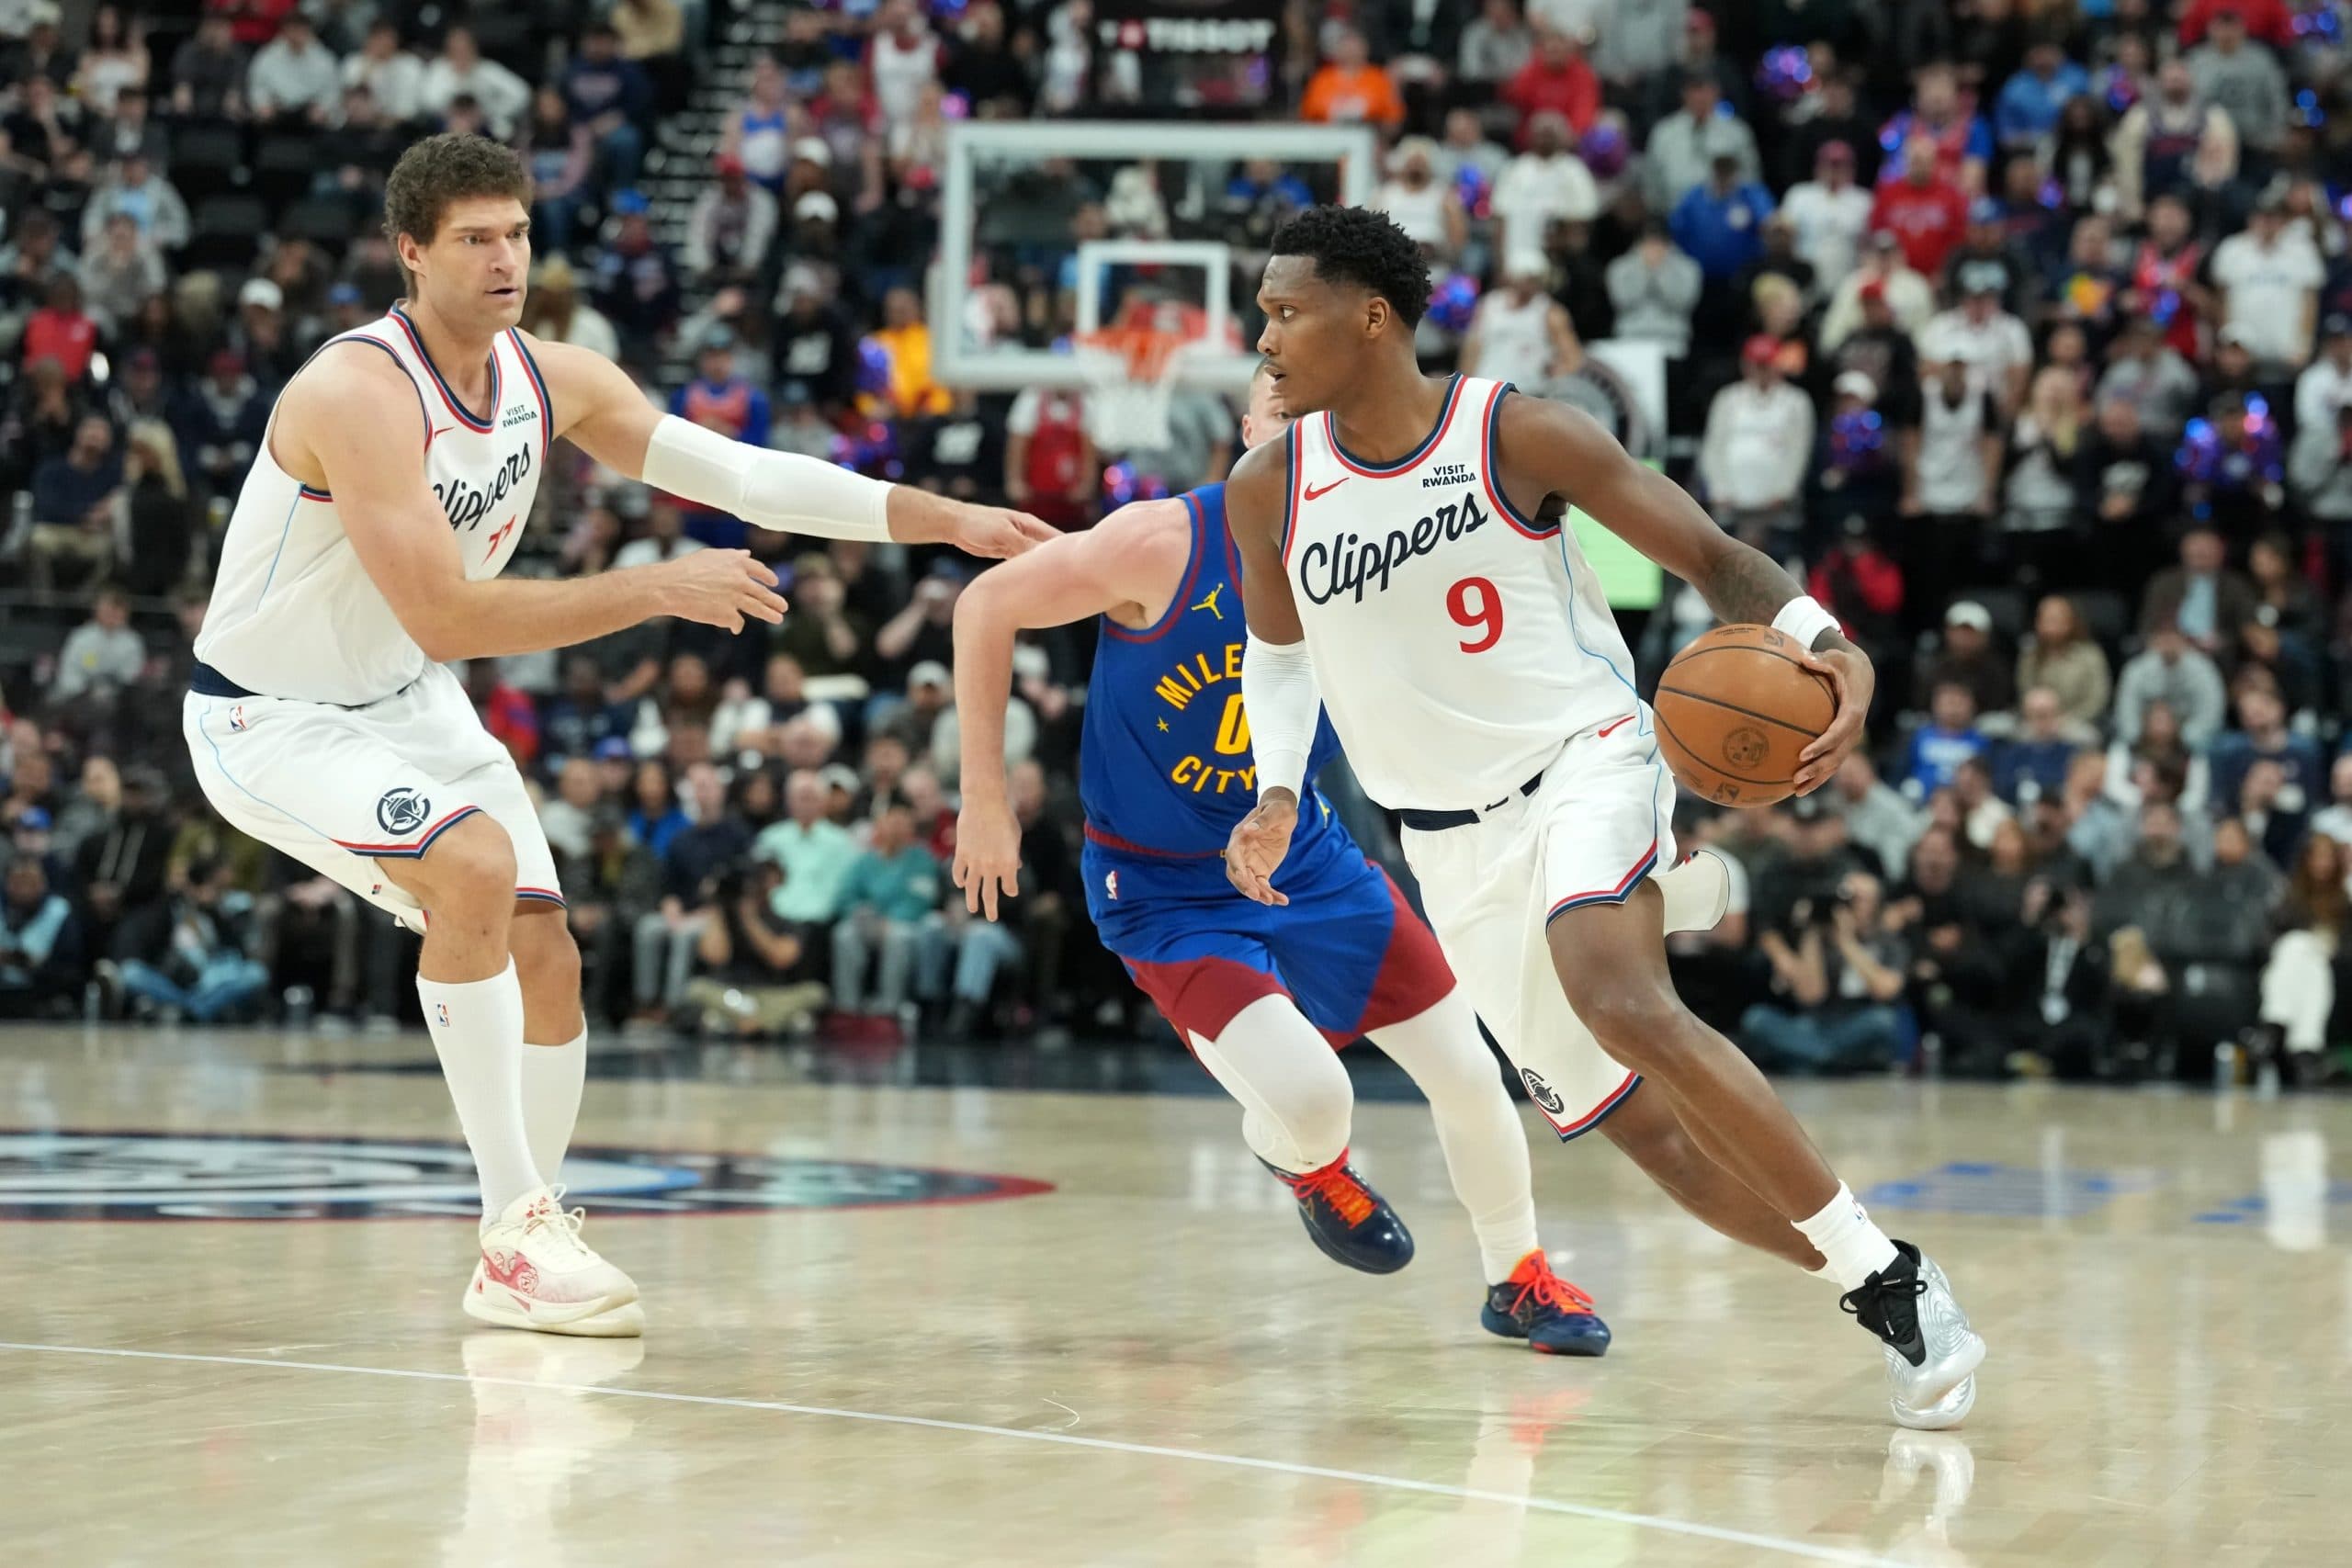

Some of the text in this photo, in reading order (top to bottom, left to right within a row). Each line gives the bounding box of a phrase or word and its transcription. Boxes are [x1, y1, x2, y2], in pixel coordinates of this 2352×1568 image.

[502, 411, 537, 428] RWANDA
[505, 404, 526, 416] VISIT
[1422, 472, 1476, 488] RWANDA
[1432, 464, 1465, 476] VISIT
[1300, 491, 1488, 604] Clippers
[1445, 576, 1504, 654] 9
[1155, 643, 1243, 711] MILE
[1171, 756, 1256, 794] CITY
